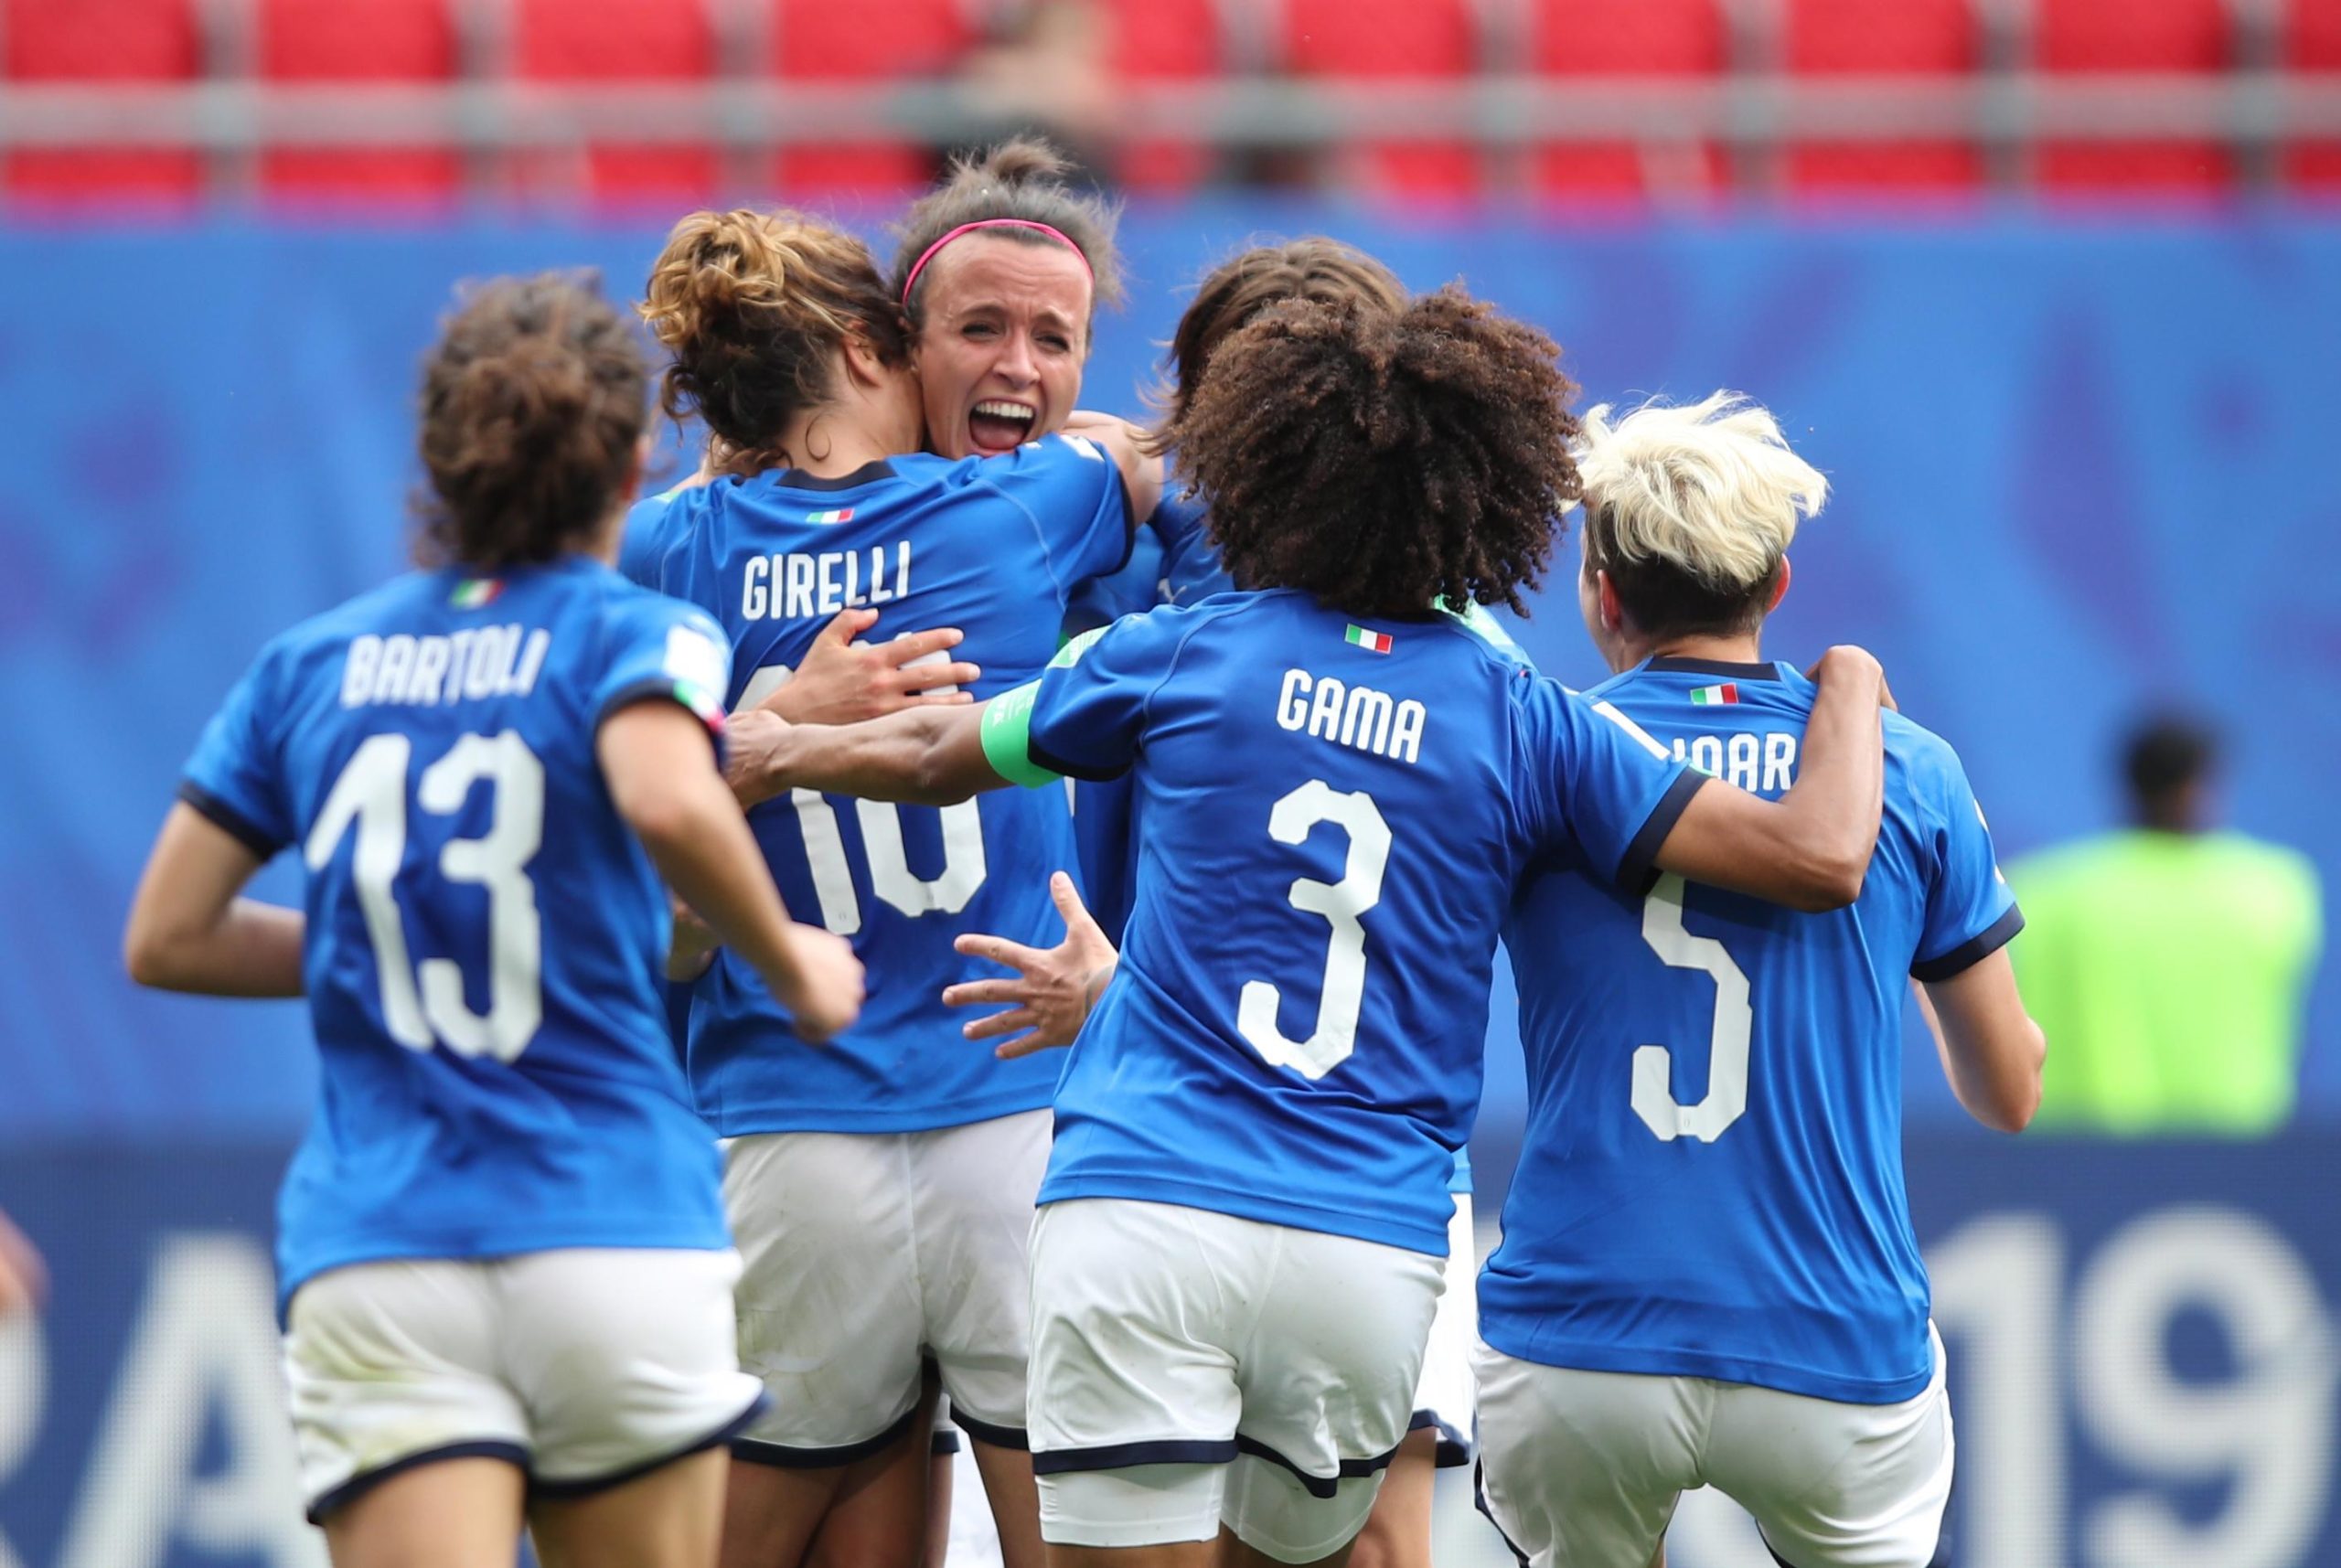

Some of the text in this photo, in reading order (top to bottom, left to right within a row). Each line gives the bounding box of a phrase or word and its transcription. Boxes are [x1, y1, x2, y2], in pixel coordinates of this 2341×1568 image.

[340, 623, 551, 709] BARTOLI
[742, 540, 911, 621] GIRELLI
[1275, 667, 1427, 764] GAMA
[305, 730, 546, 1062] 13
[732, 631, 988, 935] 10
[1236, 778, 1394, 1081] 3
[1630, 871, 1753, 1144] 5
